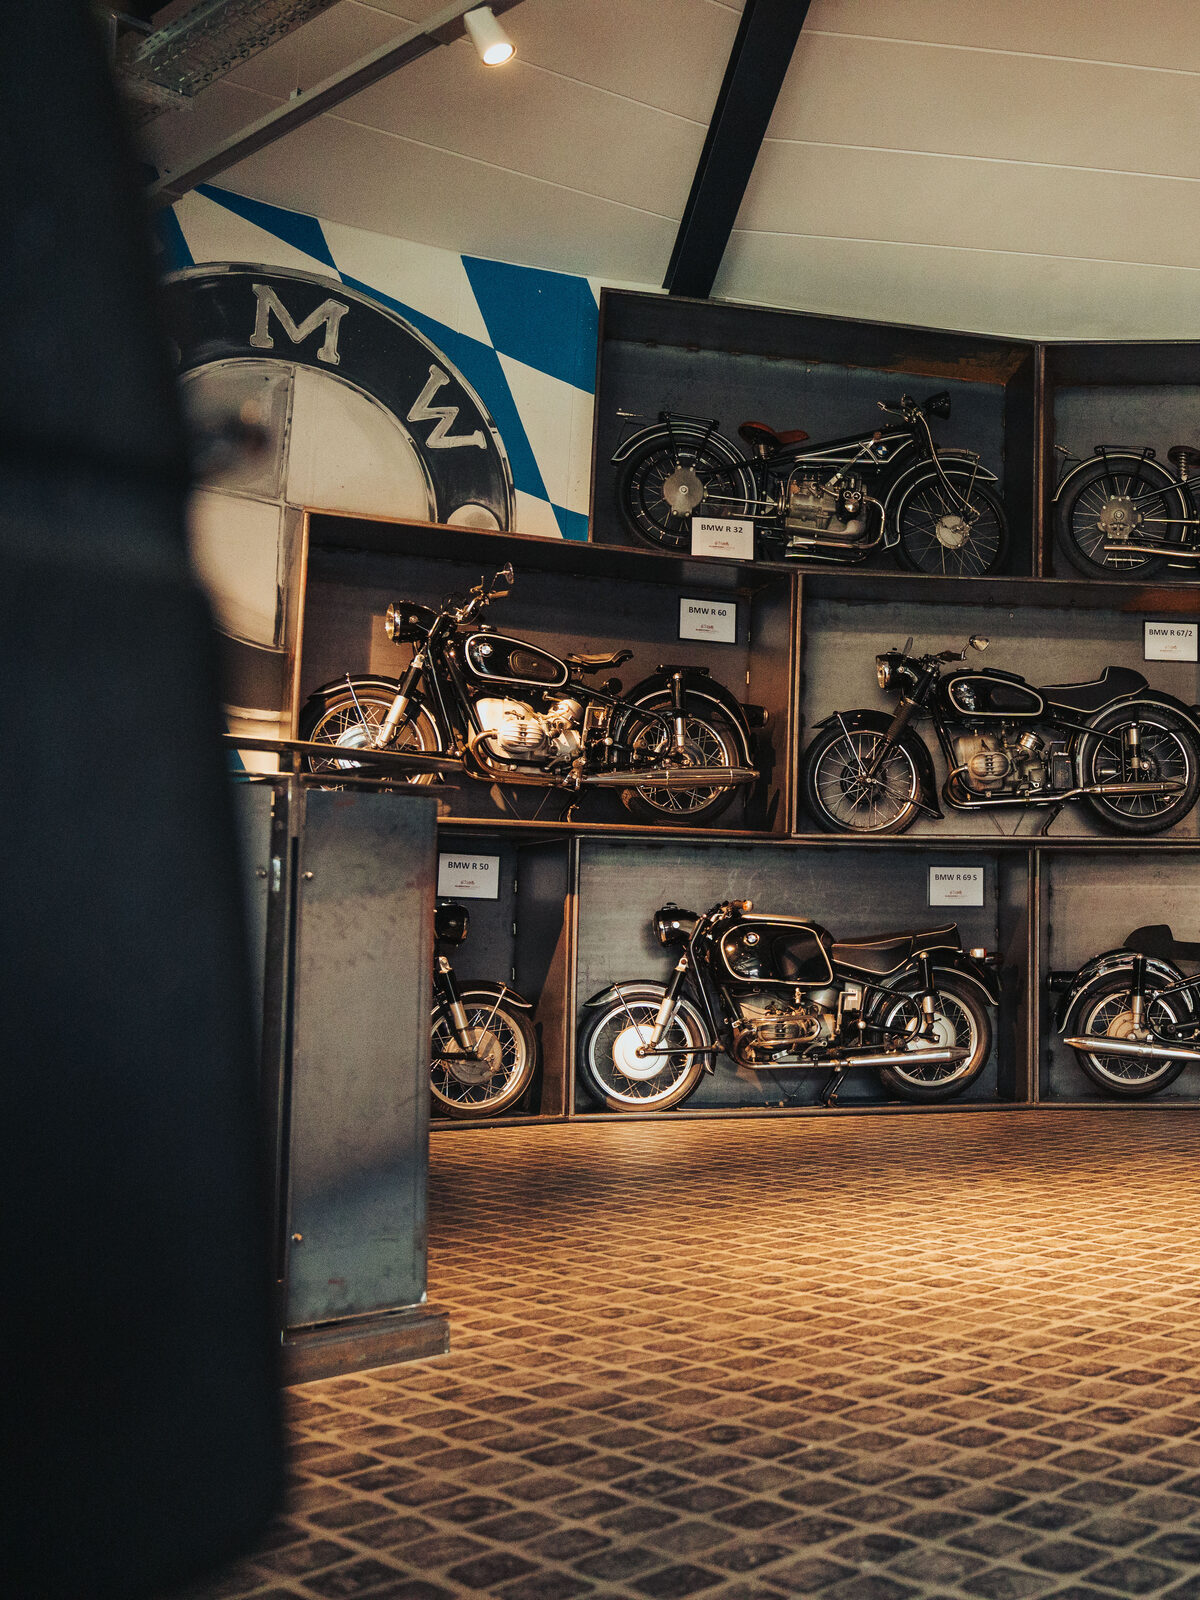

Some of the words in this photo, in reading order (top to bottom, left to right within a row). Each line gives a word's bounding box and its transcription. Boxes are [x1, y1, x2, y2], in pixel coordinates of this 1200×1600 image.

[176, 283, 487, 450] MW
[701, 524, 724, 532] BMW
[726, 525, 732, 533] R
[688, 607, 710, 615] BMW
[1176, 629, 1193, 637] 67/2
[448, 861, 470, 869] BMW
